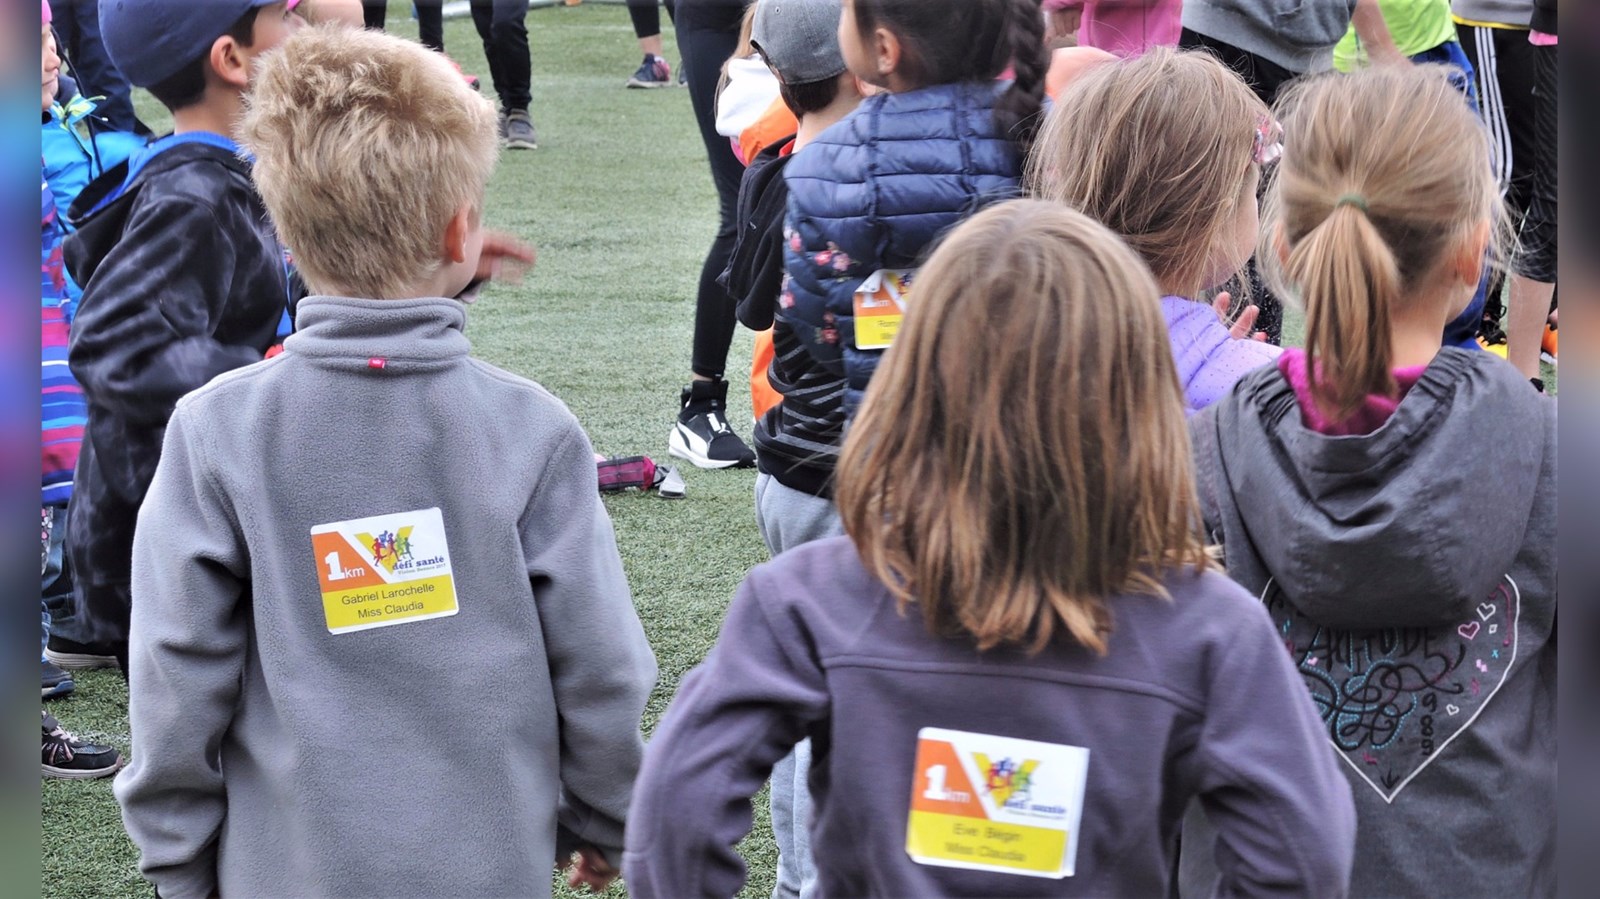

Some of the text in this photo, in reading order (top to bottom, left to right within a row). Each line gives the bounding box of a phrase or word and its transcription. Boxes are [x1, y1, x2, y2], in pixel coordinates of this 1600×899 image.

[416, 555, 445, 567] santé
[341, 583, 435, 606] Gabriel Larochelle
[358, 601, 424, 619] Miss Claudia
